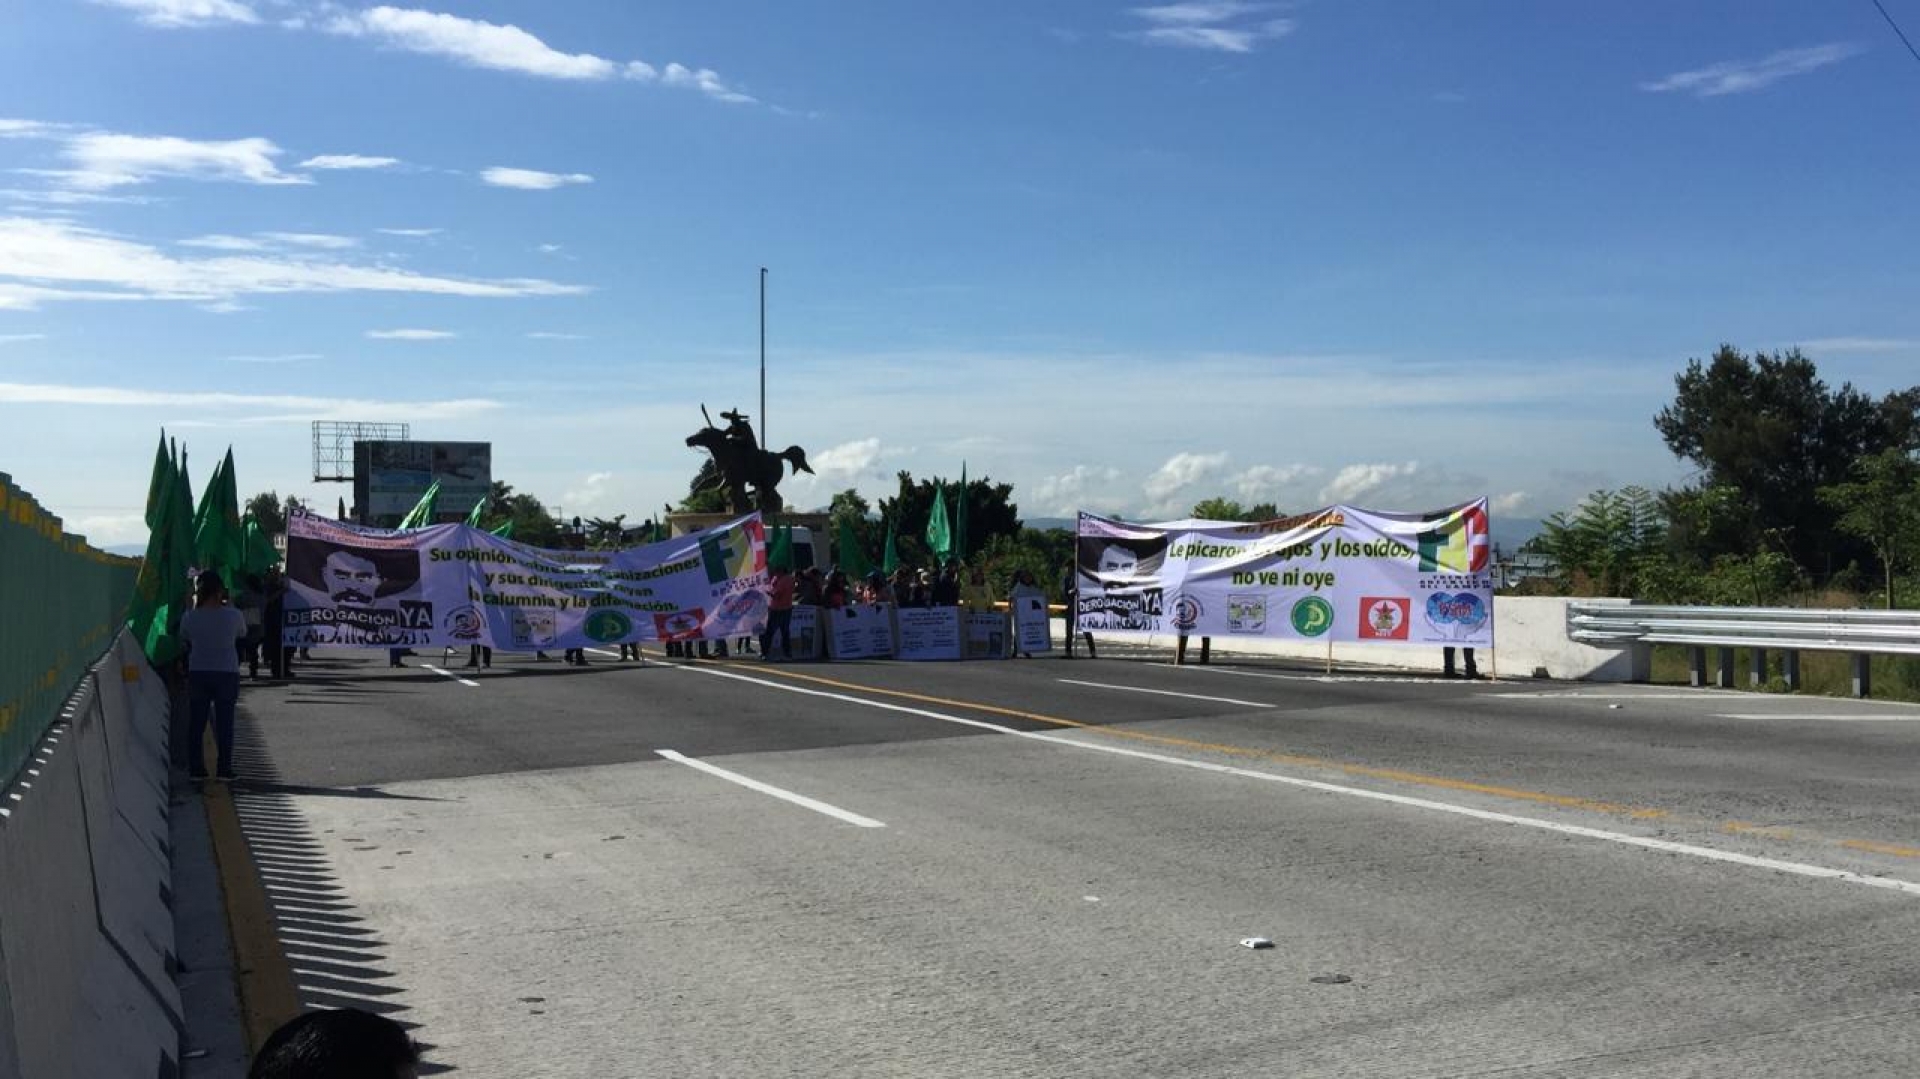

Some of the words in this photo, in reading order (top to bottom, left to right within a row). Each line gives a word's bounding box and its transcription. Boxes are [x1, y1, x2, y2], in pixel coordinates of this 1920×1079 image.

[430, 548, 451, 562] Su
[1321, 542, 1333, 561] y
[1335, 537, 1360, 557] los
[484, 572, 495, 587] y
[1232, 571, 1255, 585] no
[1259, 571, 1279, 585] ve
[1283, 567, 1300, 585] ni
[1302, 571, 1335, 591] oye
[560, 595, 569, 610] y
[573, 594, 587, 608] la
[1143, 590, 1163, 612] YA
[400, 606, 432, 628] YA
